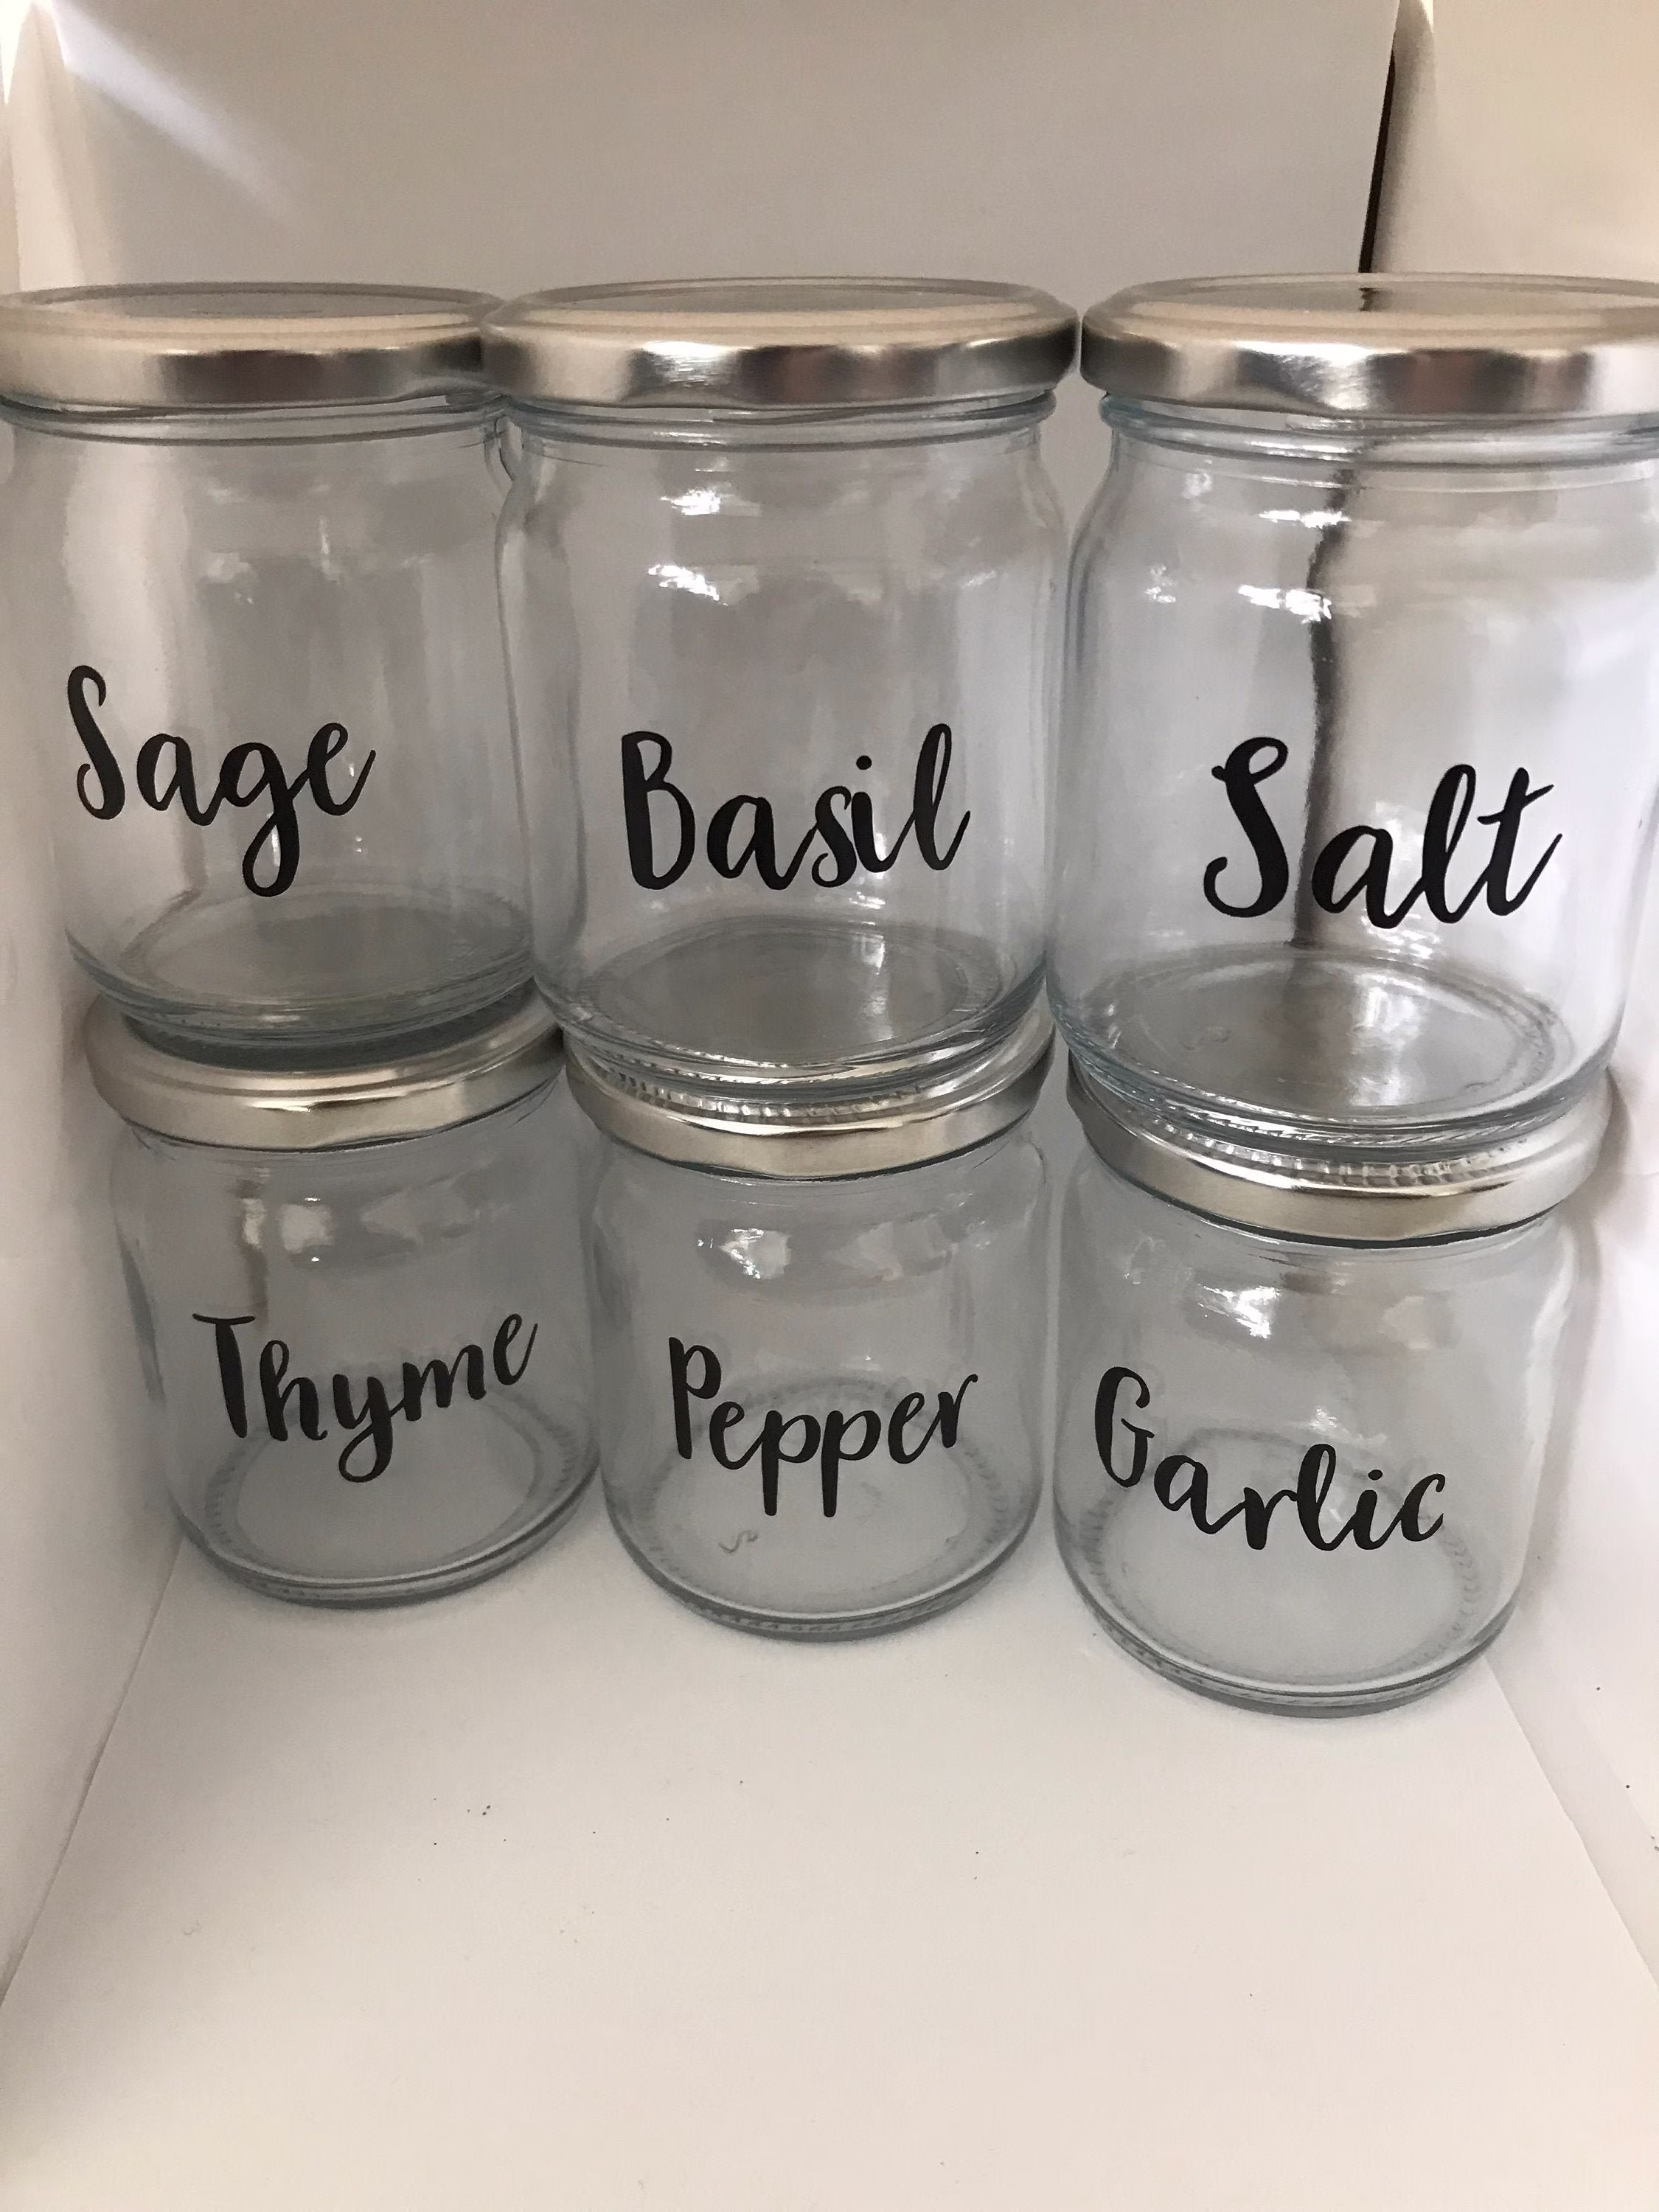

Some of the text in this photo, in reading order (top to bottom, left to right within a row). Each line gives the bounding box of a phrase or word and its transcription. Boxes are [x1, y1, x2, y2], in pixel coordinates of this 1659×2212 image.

[66, 664, 378, 899] Sage
[620, 722, 972, 891] Basil
[1203, 736, 1564, 929] Salt
[191, 1312, 539, 1484] Thyme
[667, 1335, 979, 1519] Pepper
[1093, 1366, 1447, 1552] Garlic
